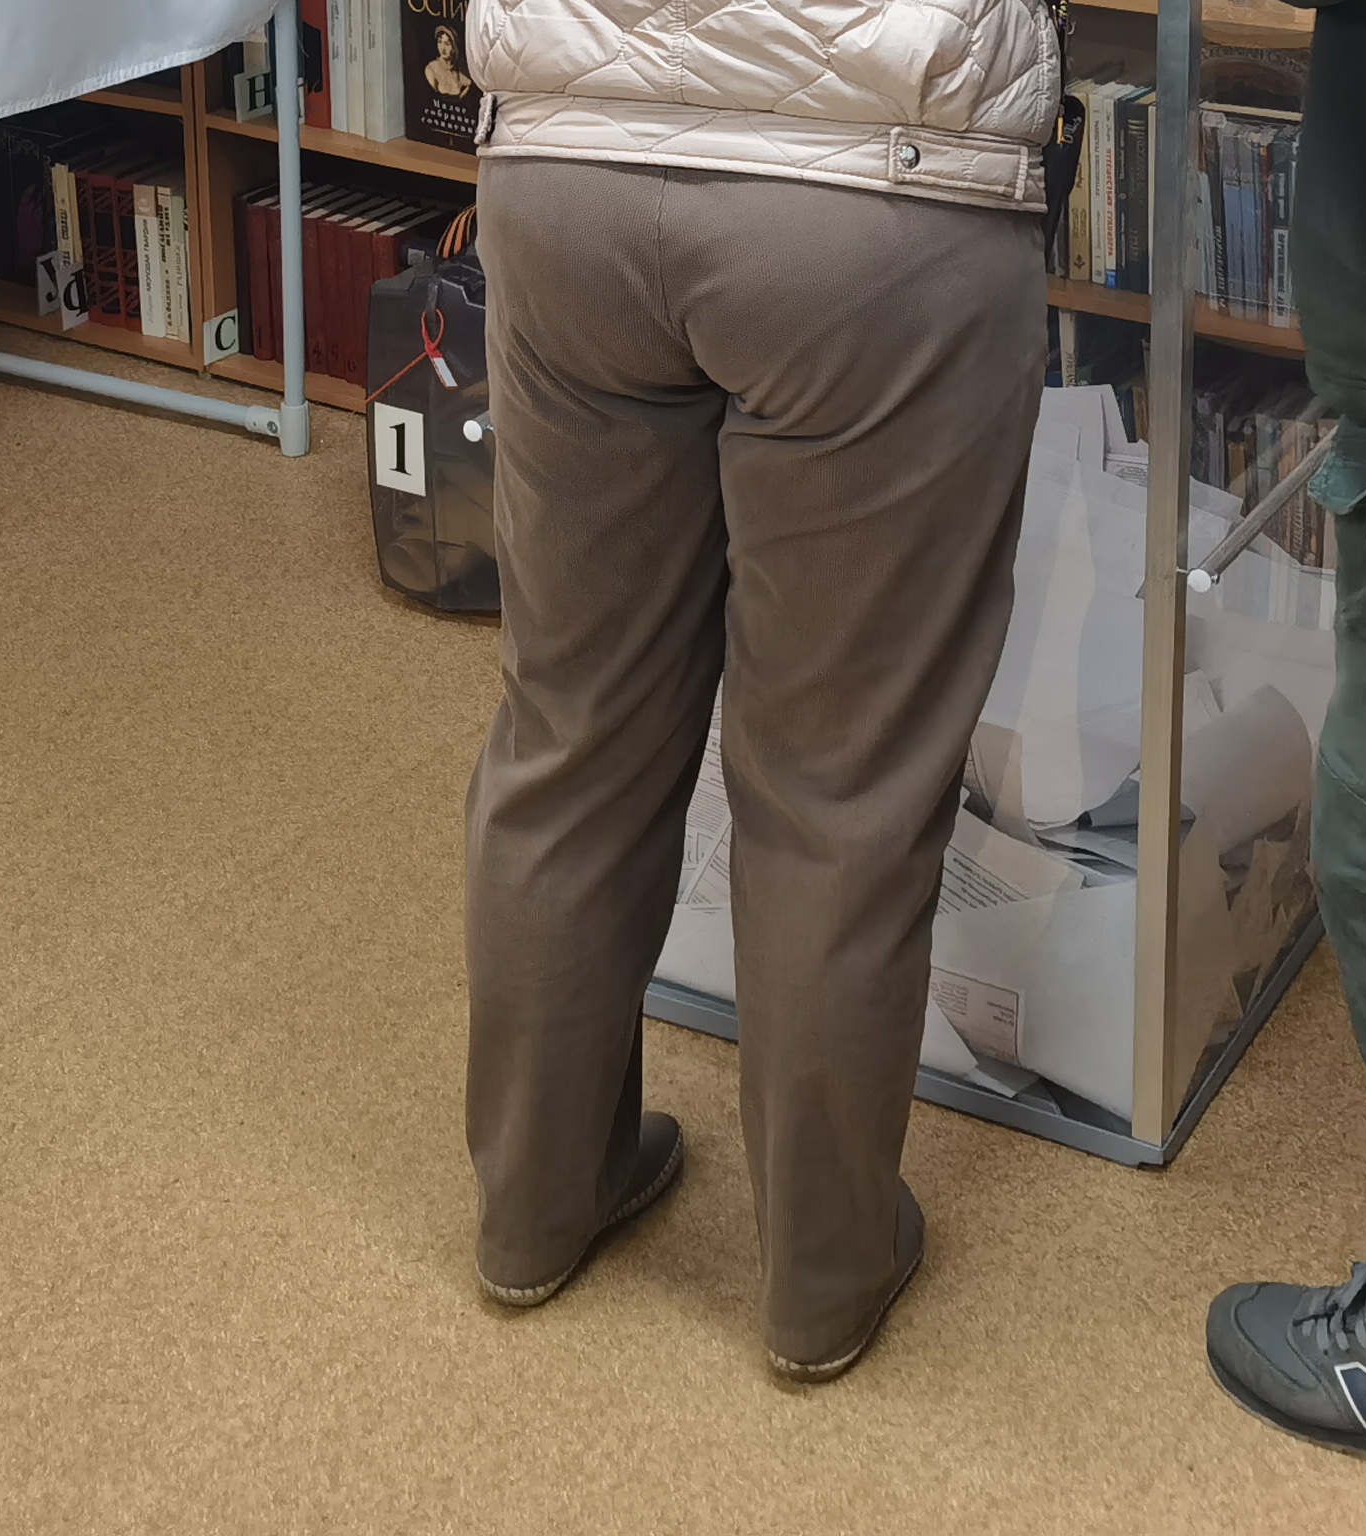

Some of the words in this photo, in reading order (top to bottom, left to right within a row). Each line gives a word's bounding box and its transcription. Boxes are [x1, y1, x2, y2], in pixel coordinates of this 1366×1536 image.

[247, 74, 271, 112] Н
[214, 310, 237, 352] С
[389, 422, 412, 476] 1
